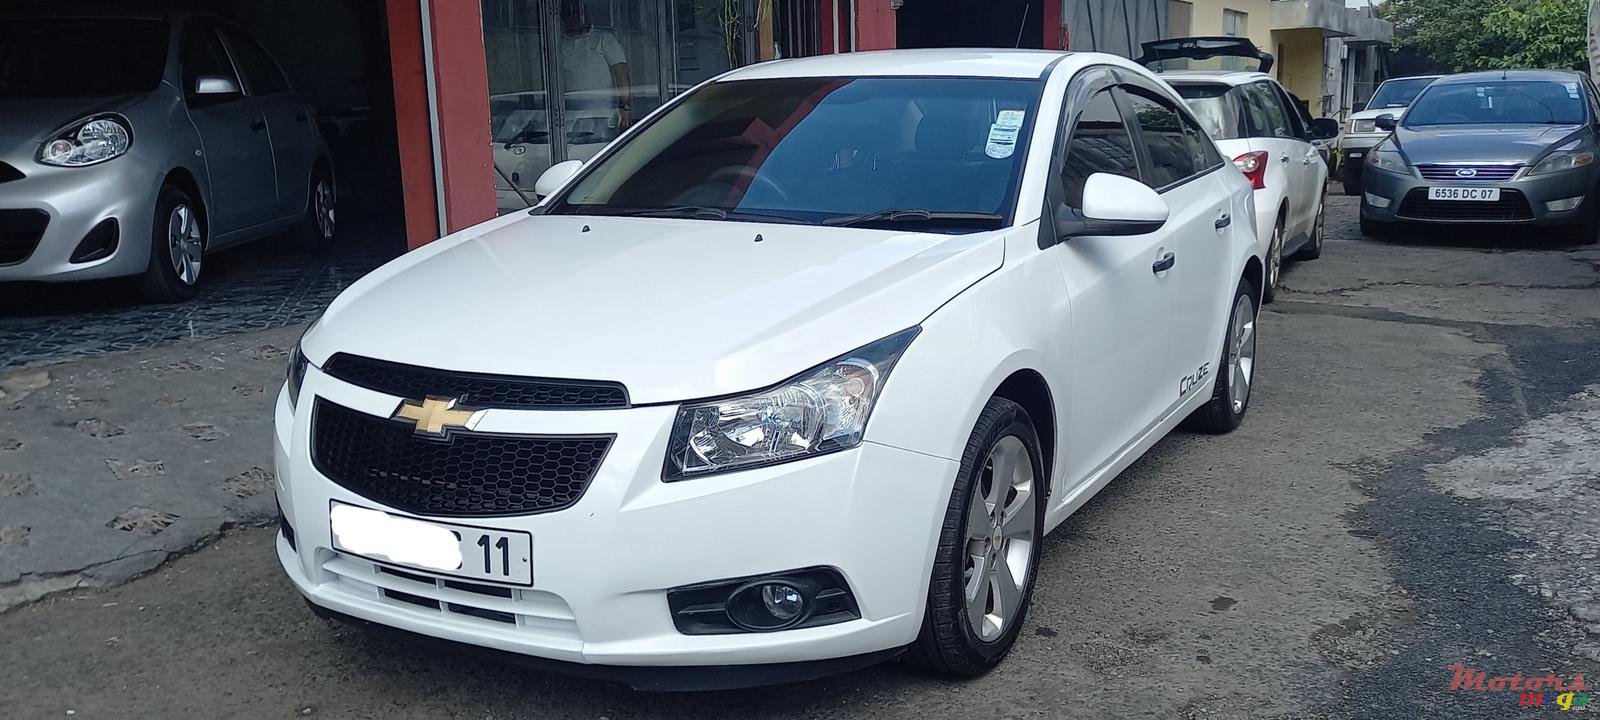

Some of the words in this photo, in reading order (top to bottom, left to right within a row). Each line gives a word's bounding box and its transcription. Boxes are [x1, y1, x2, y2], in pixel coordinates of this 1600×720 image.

[1435, 188, 1459, 199] 6536
[1461, 189, 1478, 199] DC
[1481, 189, 1494, 199] 07
[476, 534, 510, 576] 11
